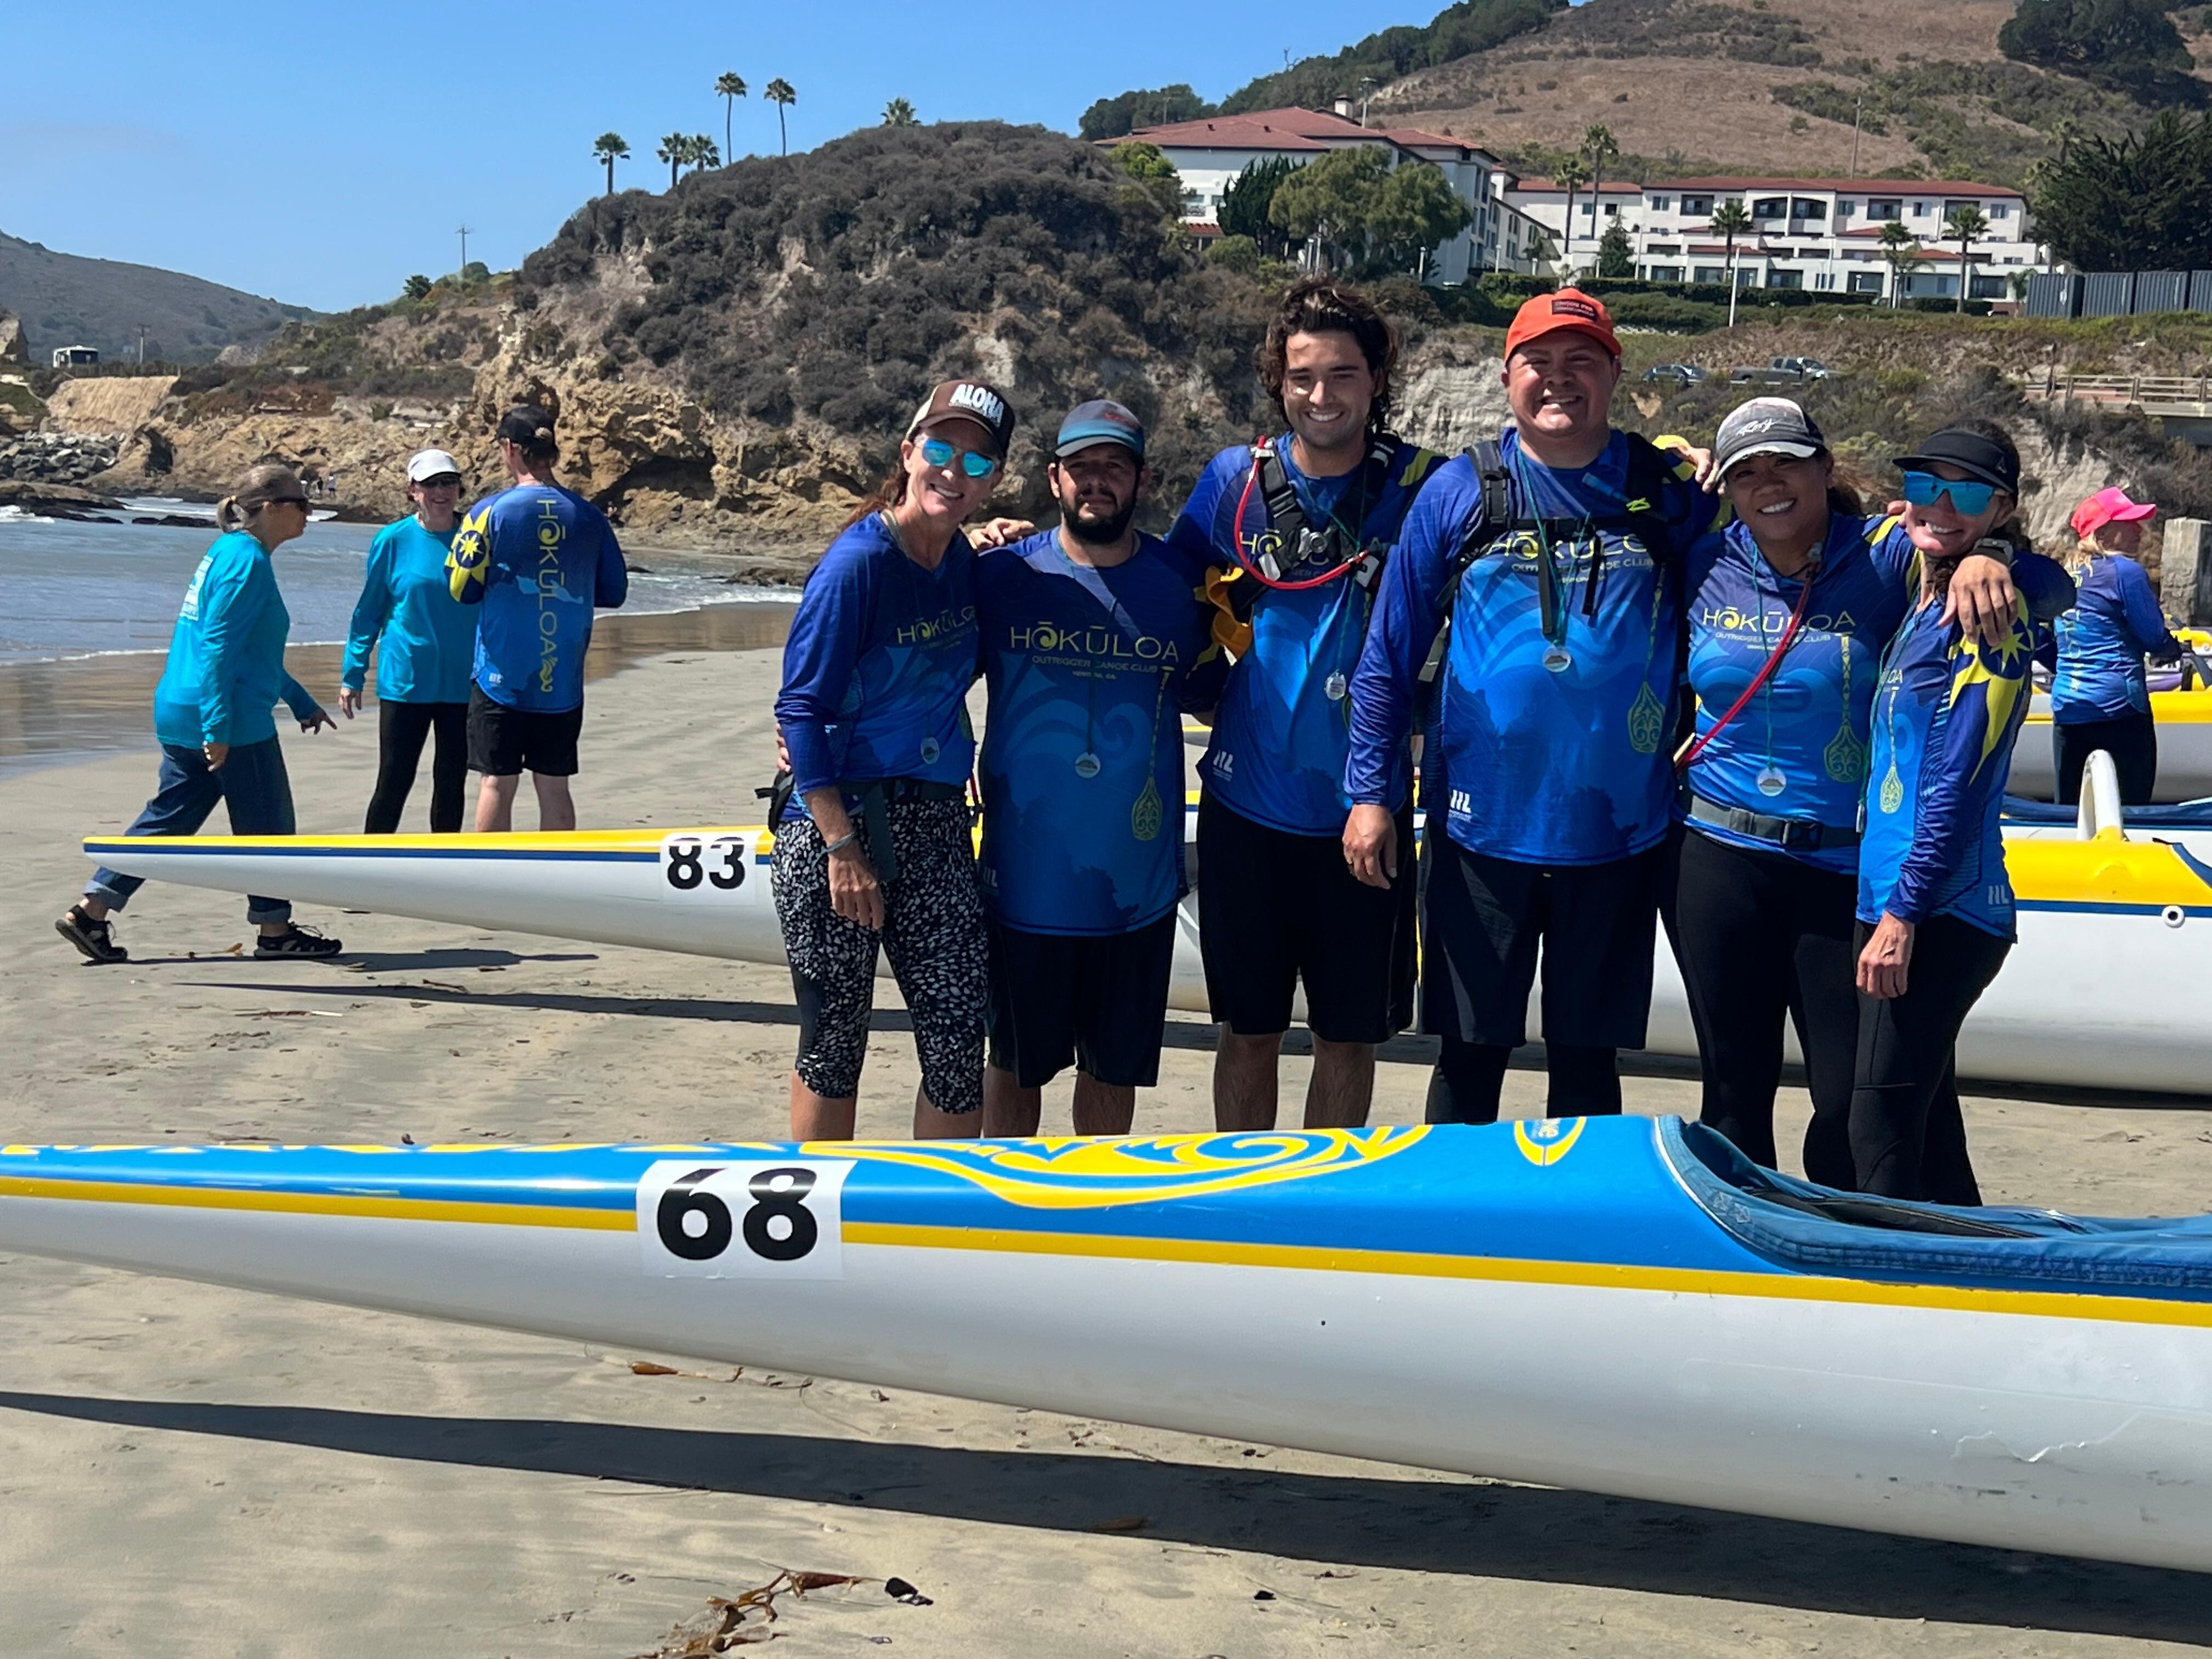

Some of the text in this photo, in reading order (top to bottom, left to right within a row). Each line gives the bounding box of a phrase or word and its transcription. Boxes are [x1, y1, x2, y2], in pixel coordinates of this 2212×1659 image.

[949, 383, 1005, 427] ALOHA
[537, 499, 566, 657] HŌKŪLOA
[1011, 621, 1179, 663] HŌKŪLOA
[667, 837, 746, 890] 83
[657, 1167, 818, 1261] 68
